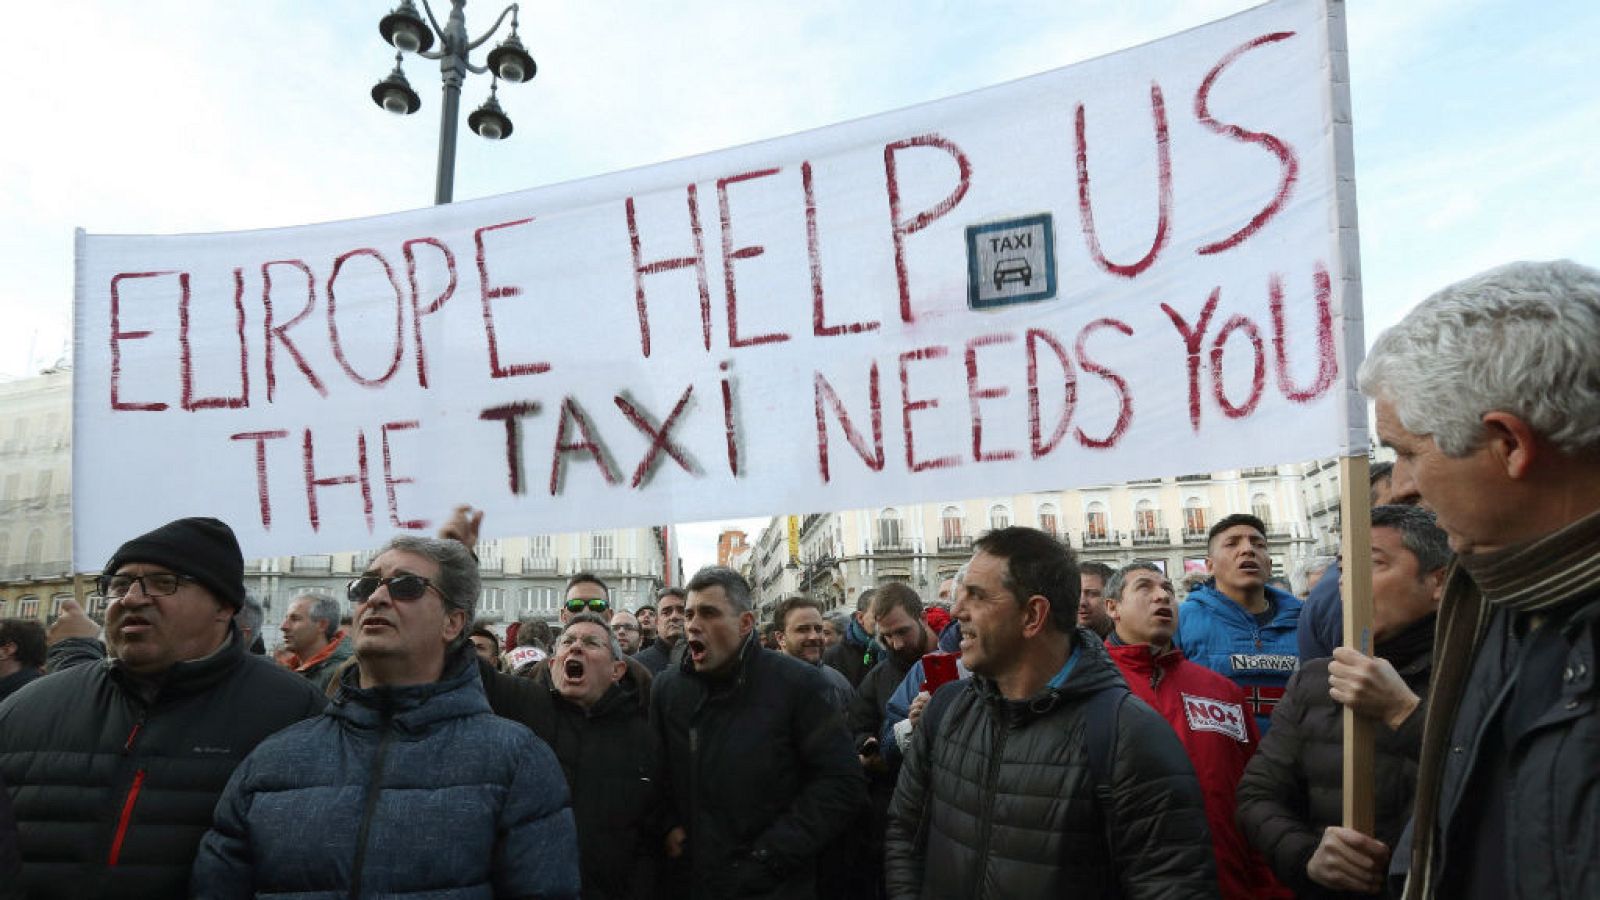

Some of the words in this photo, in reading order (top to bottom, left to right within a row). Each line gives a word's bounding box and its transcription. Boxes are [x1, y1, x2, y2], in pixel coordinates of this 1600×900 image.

[110, 218, 551, 411] EUROPE
[626, 133, 971, 357] HELP
[1075, 31, 1299, 278] US
[989, 232, 1032, 253] TAXI
[231, 419, 430, 533] THE
[813, 317, 1134, 483] NEEDS
[1160, 260, 1338, 435] YOU
